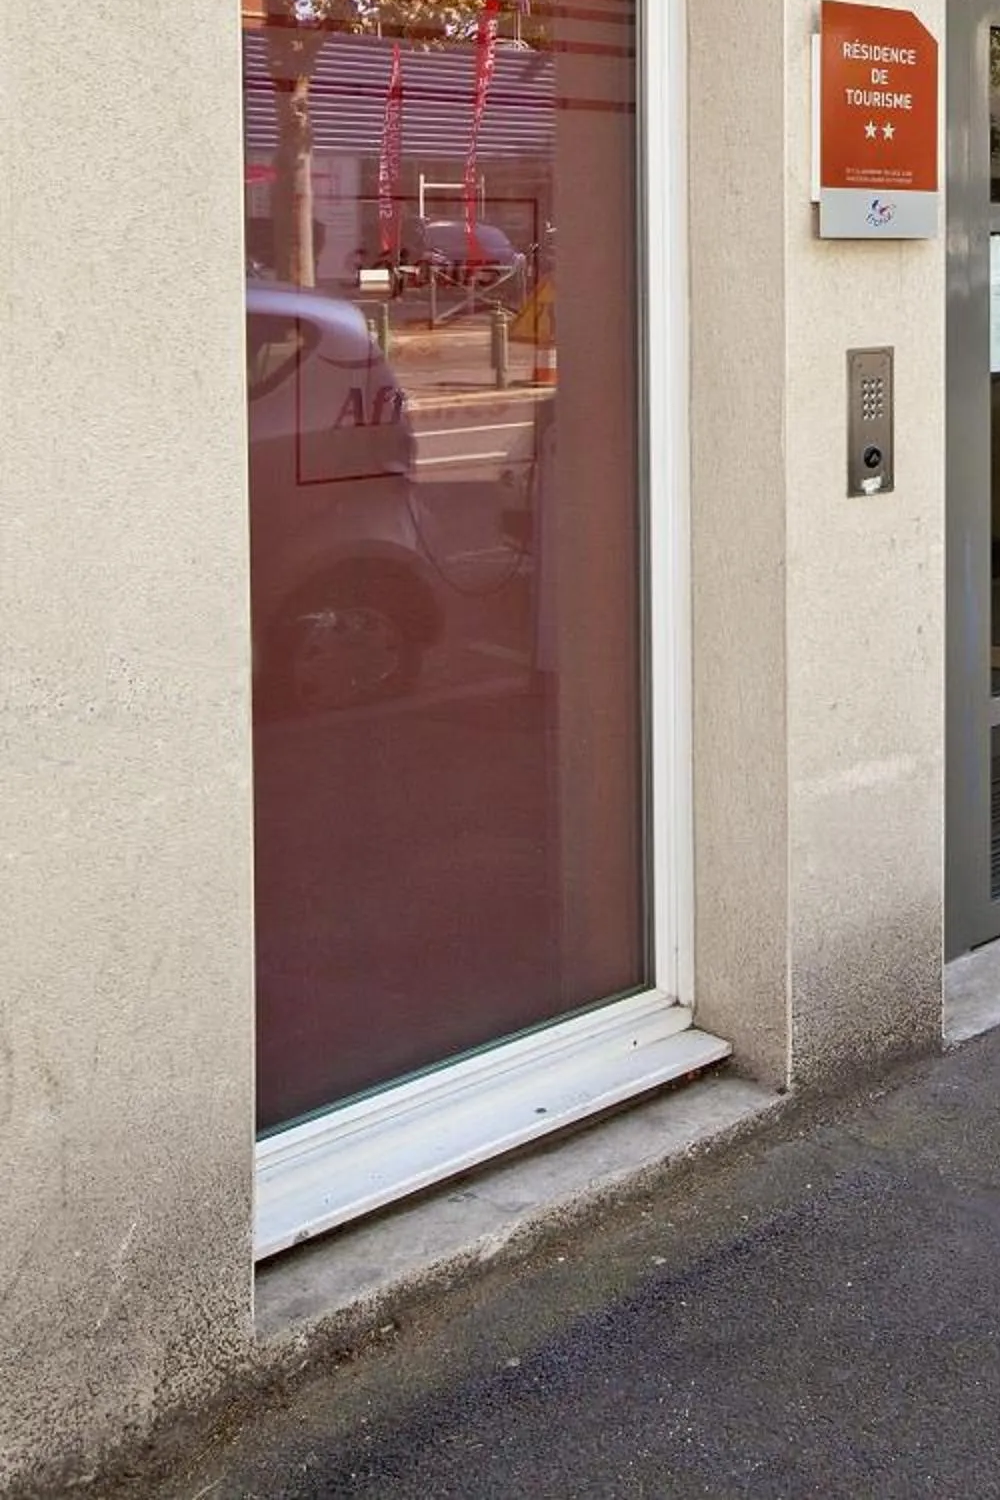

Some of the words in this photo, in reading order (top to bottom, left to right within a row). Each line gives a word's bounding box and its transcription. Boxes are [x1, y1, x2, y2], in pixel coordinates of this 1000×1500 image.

[843, 39, 917, 66] RÉSIDENCE
[871, 68, 890, 85] DE
[845, 88, 914, 110] TOURISME
